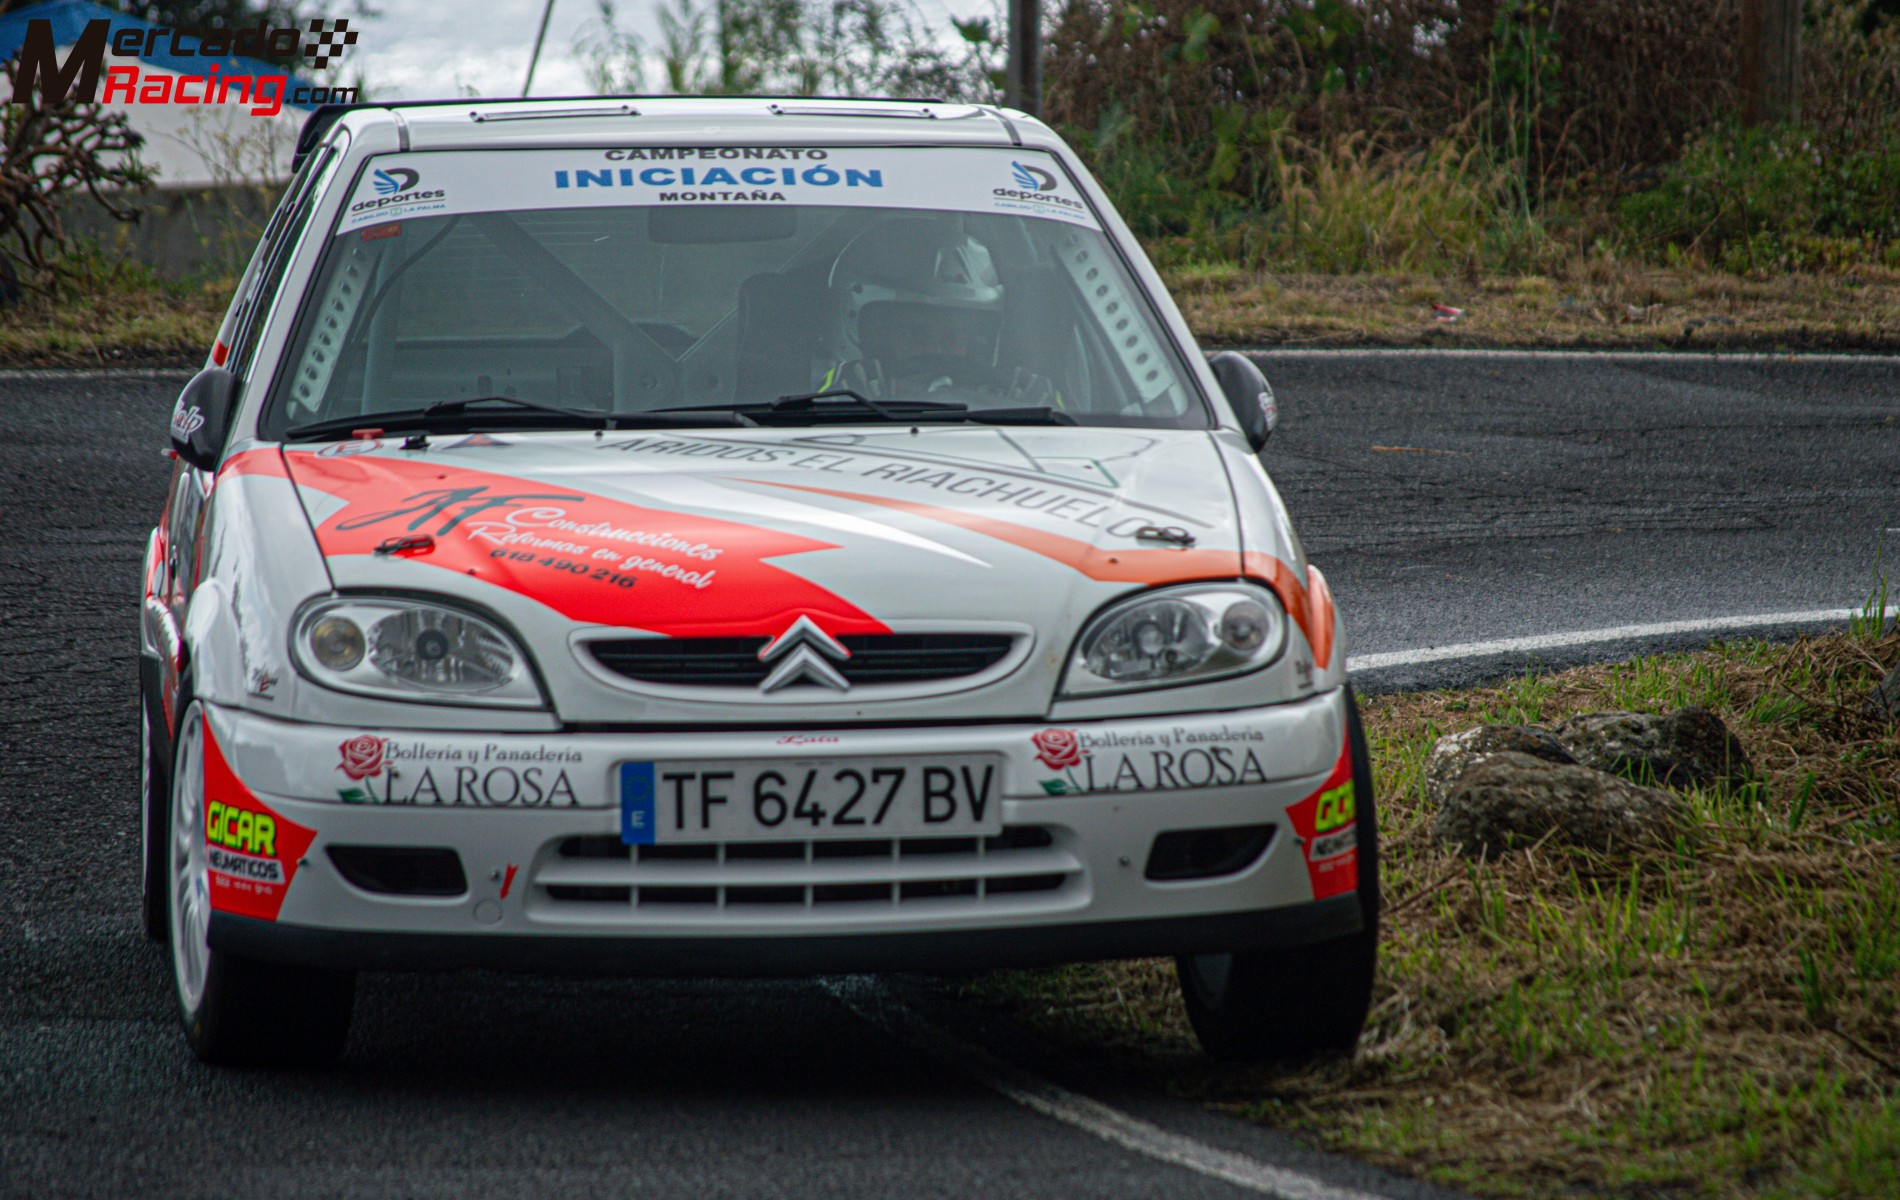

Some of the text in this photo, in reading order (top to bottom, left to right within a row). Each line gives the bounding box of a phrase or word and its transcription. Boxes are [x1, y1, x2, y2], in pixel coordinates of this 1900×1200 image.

[604, 148, 828, 161] CAMPEONATO
[555, 164, 883, 188] INICIACIÓN
[351, 189, 446, 212] deportes
[659, 190, 787, 202] MONTAÑA
[992, 188, 1084, 209] deportes
[595, 438, 796, 463] ARIDOS
[788, 454, 855, 473] EL
[505, 506, 724, 561] Construcciones
[466, 521, 717, 589] Reformas en general
[490, 548, 638, 589] 618 490 216
[1158, 735, 1171, 747] y
[467, 749, 479, 764] y
[1151, 747, 1268, 788] ROSA
[454, 766, 580, 806] ROSA
[662, 765, 994, 830] TF 6427 BV
[207, 800, 278, 857] GICAR
[631, 809, 645, 829] E
